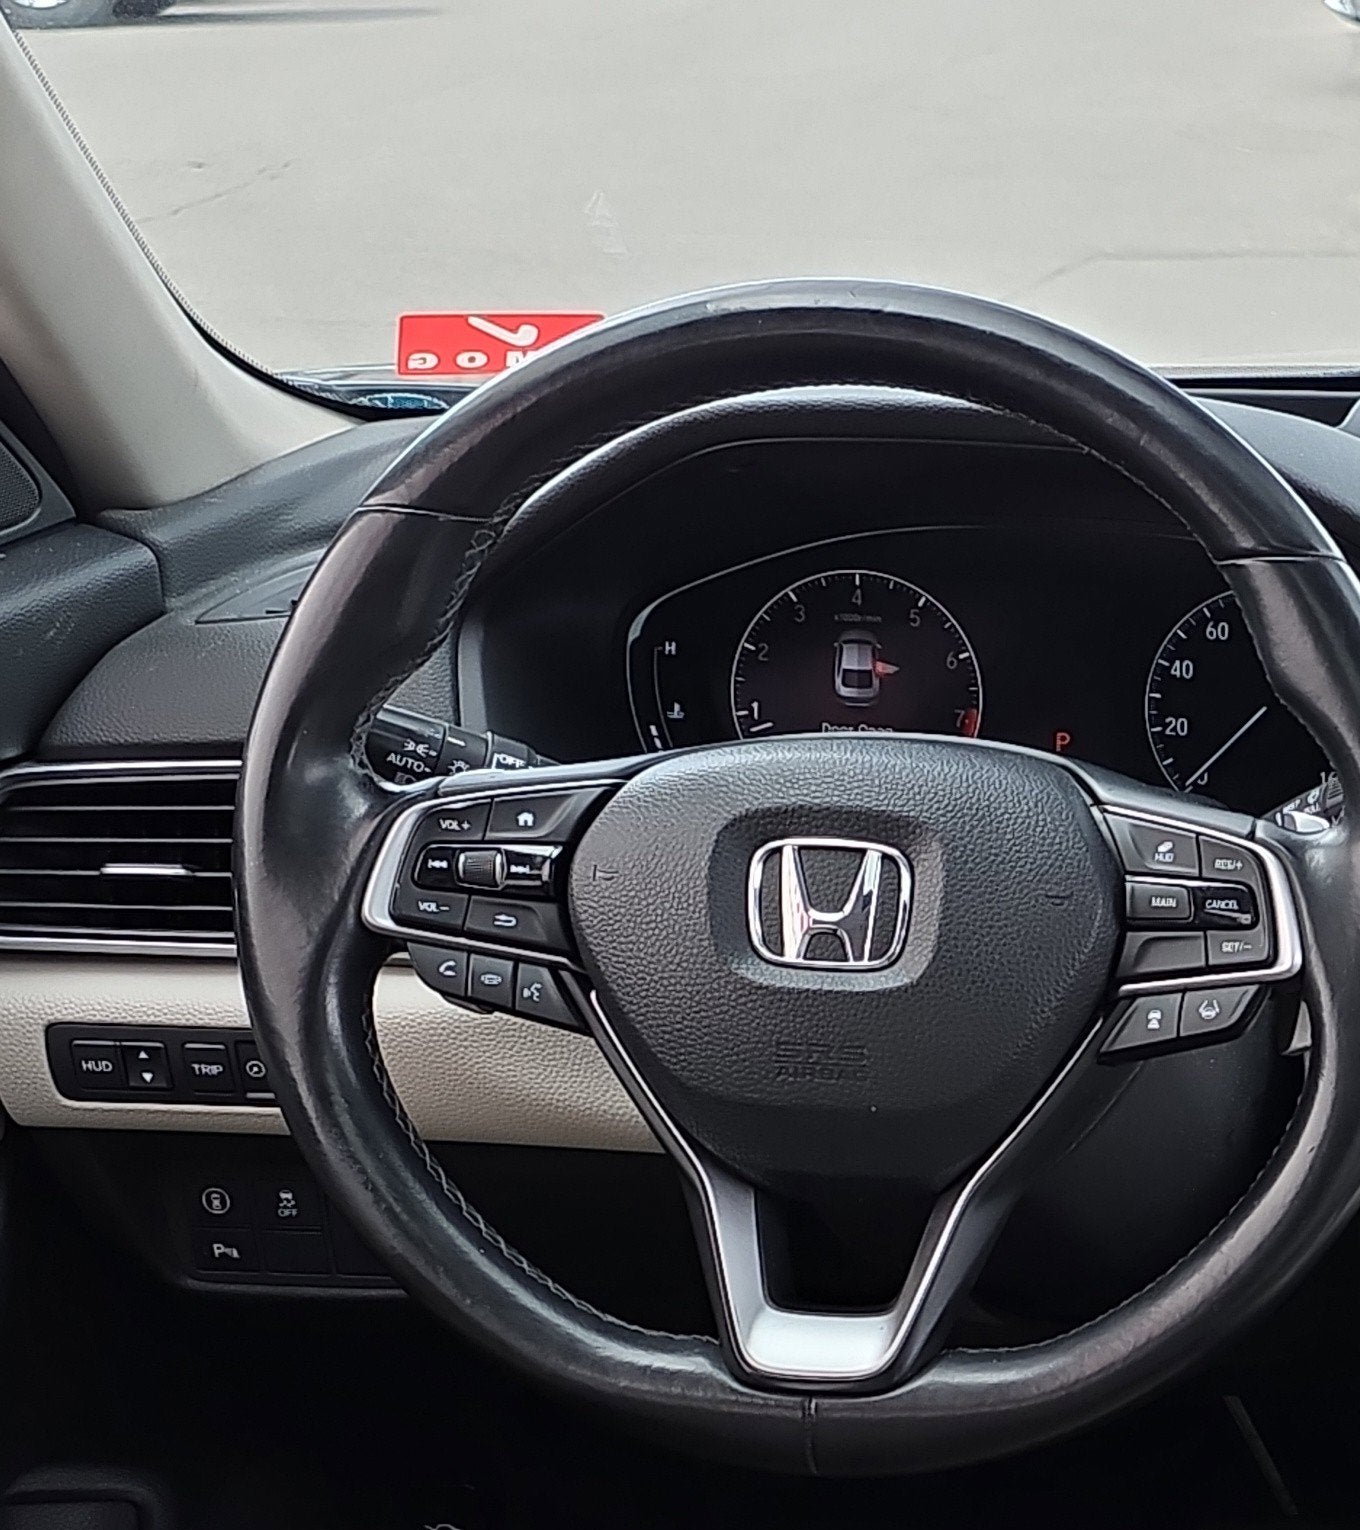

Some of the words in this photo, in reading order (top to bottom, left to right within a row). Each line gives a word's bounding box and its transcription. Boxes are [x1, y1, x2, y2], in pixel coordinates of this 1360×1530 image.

[851, 588, 863, 606] 4
[794, 605, 805, 623] 3
[909, 608, 921, 627] 5
[1205, 621, 1230, 641] 60
[664, 641, 677, 656] H
[757, 643, 769, 662] 2
[946, 651, 958, 670] 6
[1170, 659, 1194, 679] 40
[750, 700, 759, 721] 1
[1164, 717, 1188, 737] 20
[1055, 732, 1071, 752] P
[386, 752, 425, 773] AUTO
[1154, 852, 1175, 862] HUD
[1151, 896, 1177, 908] MAIN
[1205, 900, 1239, 911] CANCEL
[81, 1060, 113, 1073] HUD
[191, 1063, 224, 1077] TRIP
[278, 1208, 298, 1218] OFF
